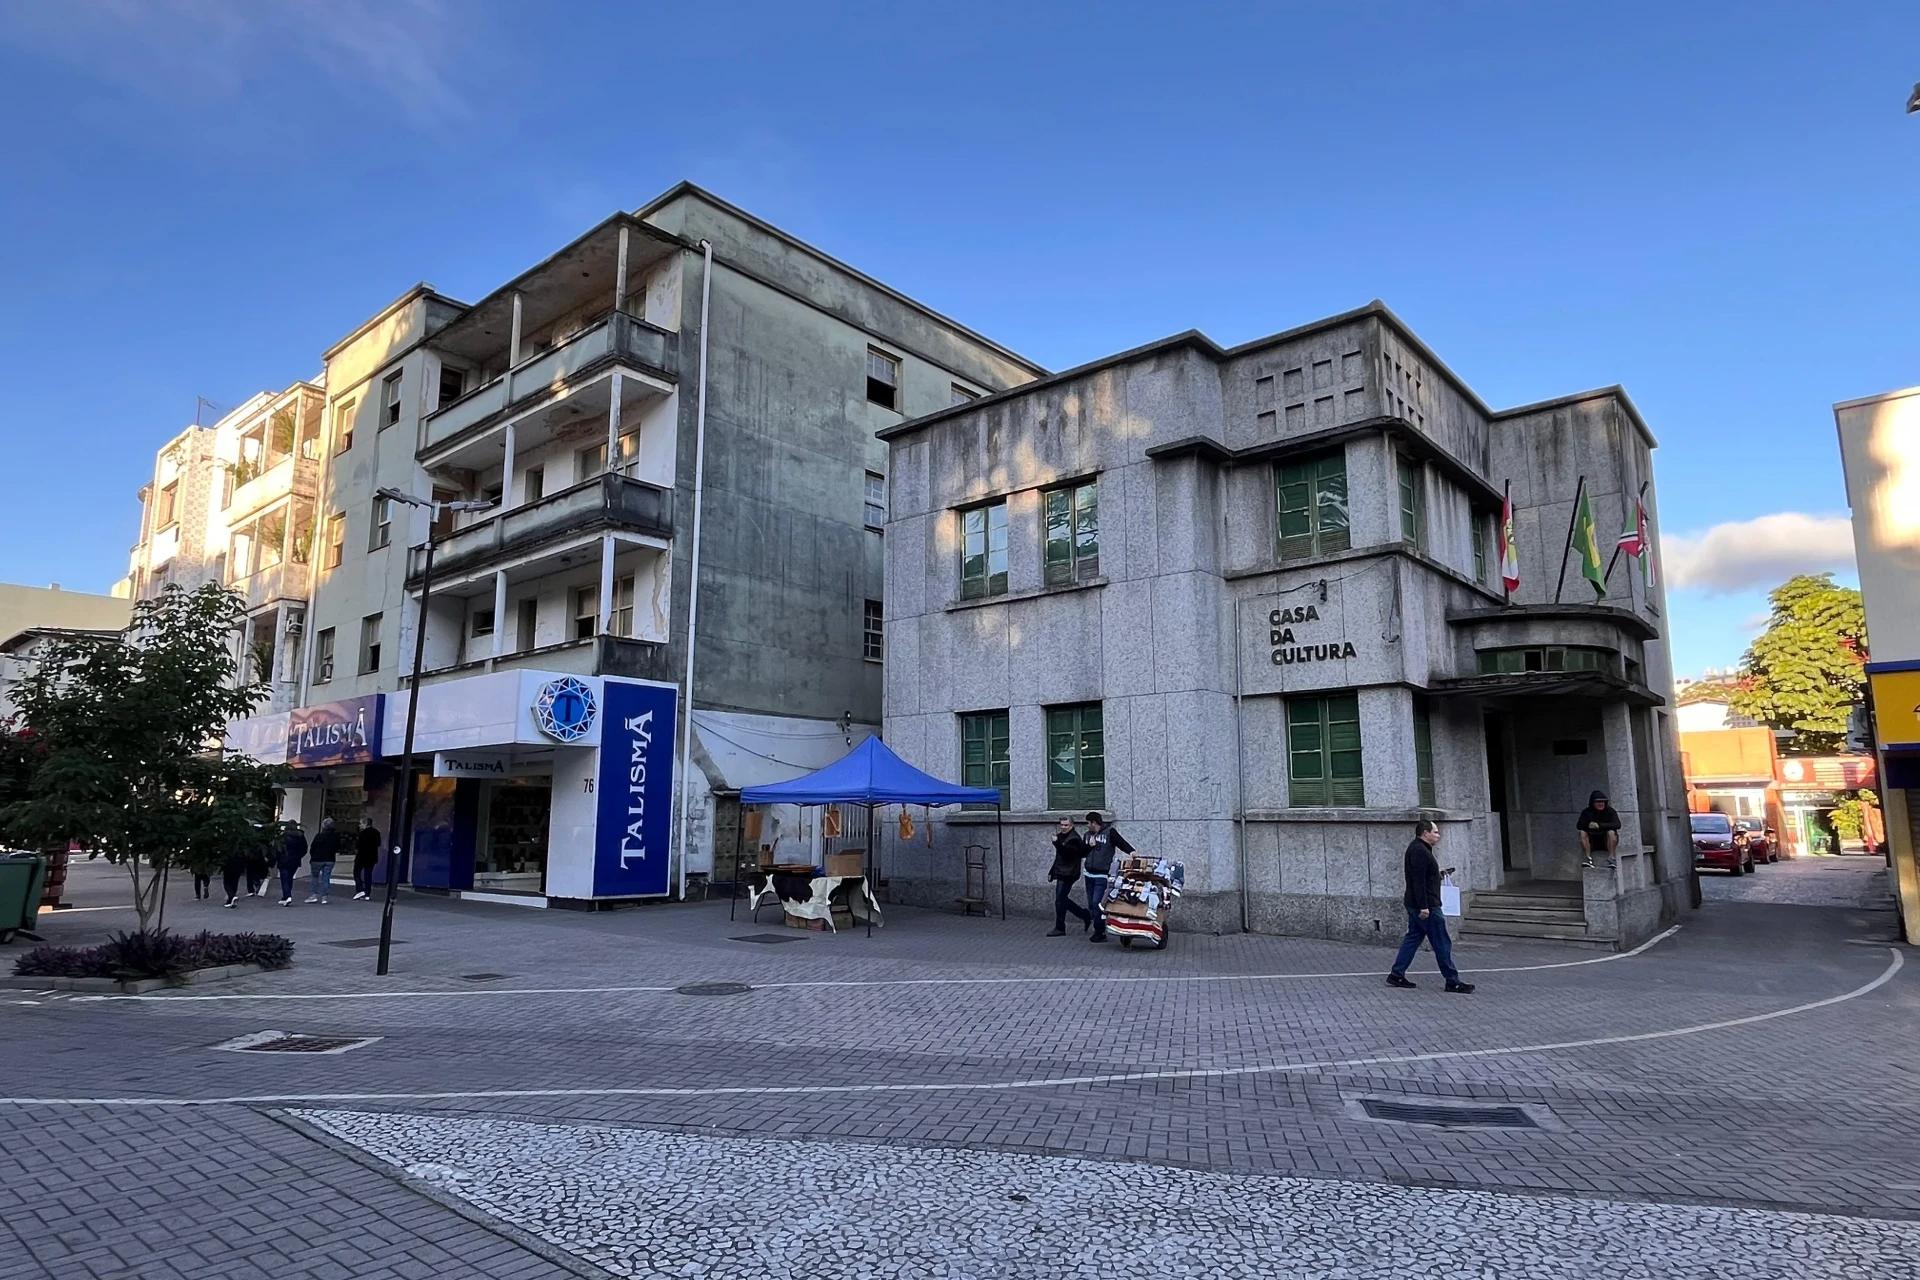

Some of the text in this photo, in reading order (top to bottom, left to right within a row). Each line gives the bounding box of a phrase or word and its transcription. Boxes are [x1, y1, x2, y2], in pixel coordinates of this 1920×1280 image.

[1269, 605, 1319, 626] CASA
[1270, 628, 1295, 646] DA
[1271, 642, 1356, 665] CULTURA
[557, 696, 581, 722] T
[584, 778, 594, 793] 76
[620, 710, 653, 869] TALISMÃ
